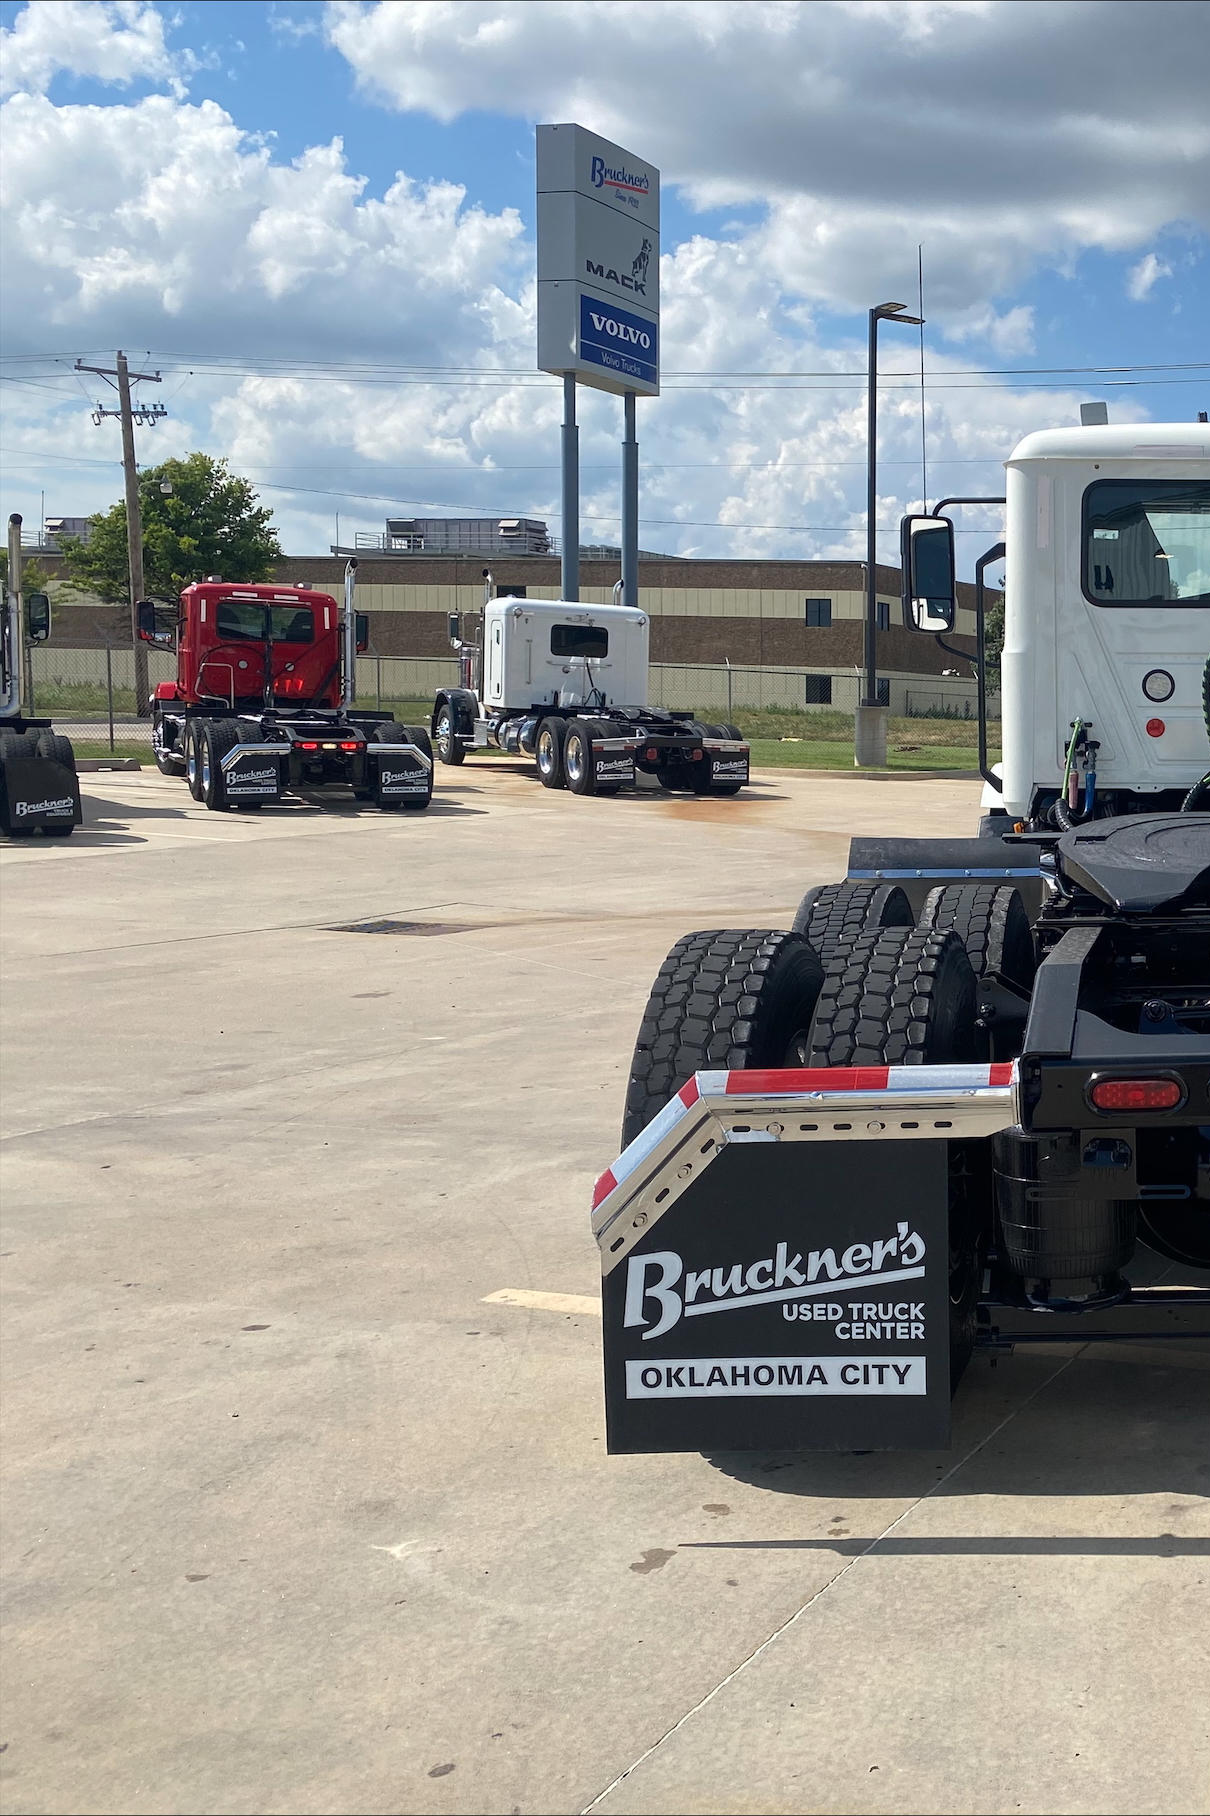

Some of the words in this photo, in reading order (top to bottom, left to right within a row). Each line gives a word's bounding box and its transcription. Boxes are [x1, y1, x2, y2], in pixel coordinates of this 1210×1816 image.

[591, 155, 650, 190] Bruckner's
[586, 259, 647, 296] MACK
[589, 312, 651, 349] VOLVO
[601, 351, 620, 368] Volvo
[620, 358, 642, 376] Trucks
[15, 796, 74, 817] Bruckner's
[623, 1221, 927, 1341] Bruckner's
[782, 1303, 843, 1322] USED
[847, 1302, 926, 1321] TRUCK
[834, 1322, 926, 1340] CENTER
[640, 1364, 829, 1389] OKLAHOMA
[839, 1363, 913, 1386] CITY
